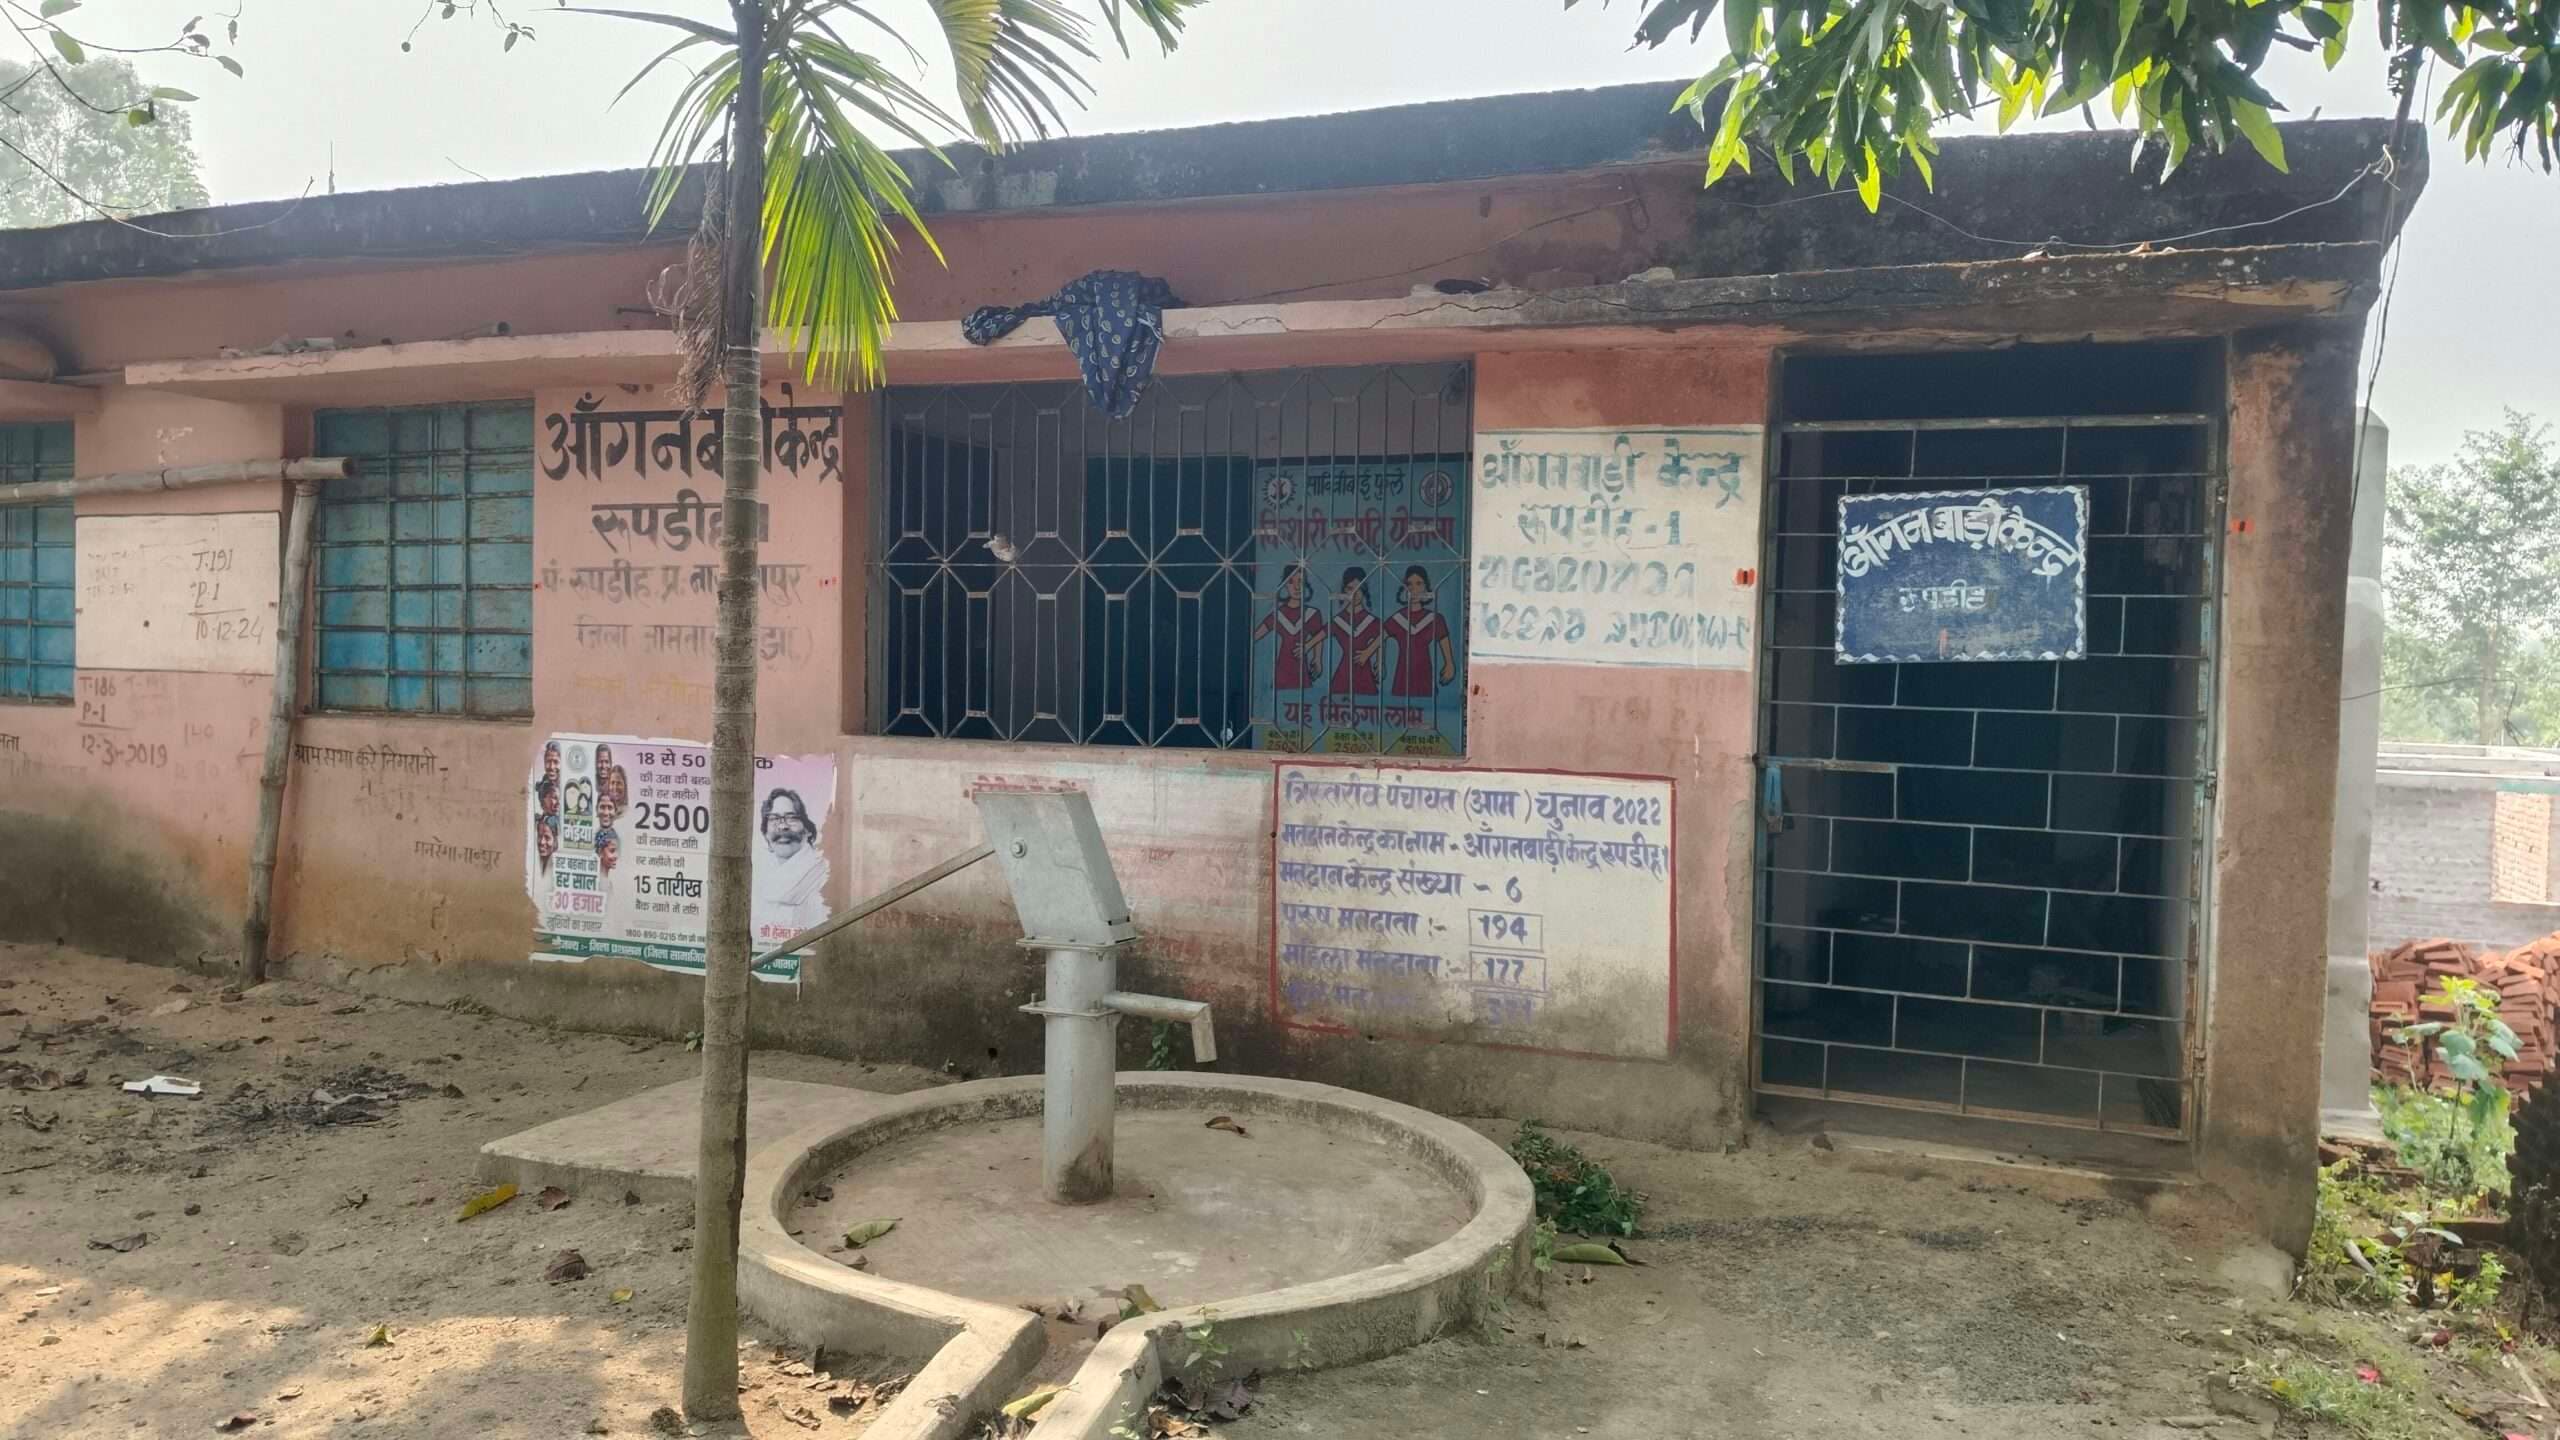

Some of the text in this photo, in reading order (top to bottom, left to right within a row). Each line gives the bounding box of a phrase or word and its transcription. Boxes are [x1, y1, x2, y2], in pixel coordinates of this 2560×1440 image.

[636, 752, 655, 765] 18
[660, 748, 676, 766] से
[681, 754, 706, 768] 50
[1387, 775, 1458, 813] पंचायत
[1535, 791, 1610, 831] चुनाव
[1612, 796, 1661, 825] 2022
[634, 802, 711, 834] 2500
[555, 870, 598, 891] हर साल
[634, 871, 703, 898] 15 तारीख
[1396, 859, 1465, 896] संख्या
[1506, 876, 1523, 903] 6
[572, 892, 604, 913] हजार
[1478, 914, 1528, 944] 194
